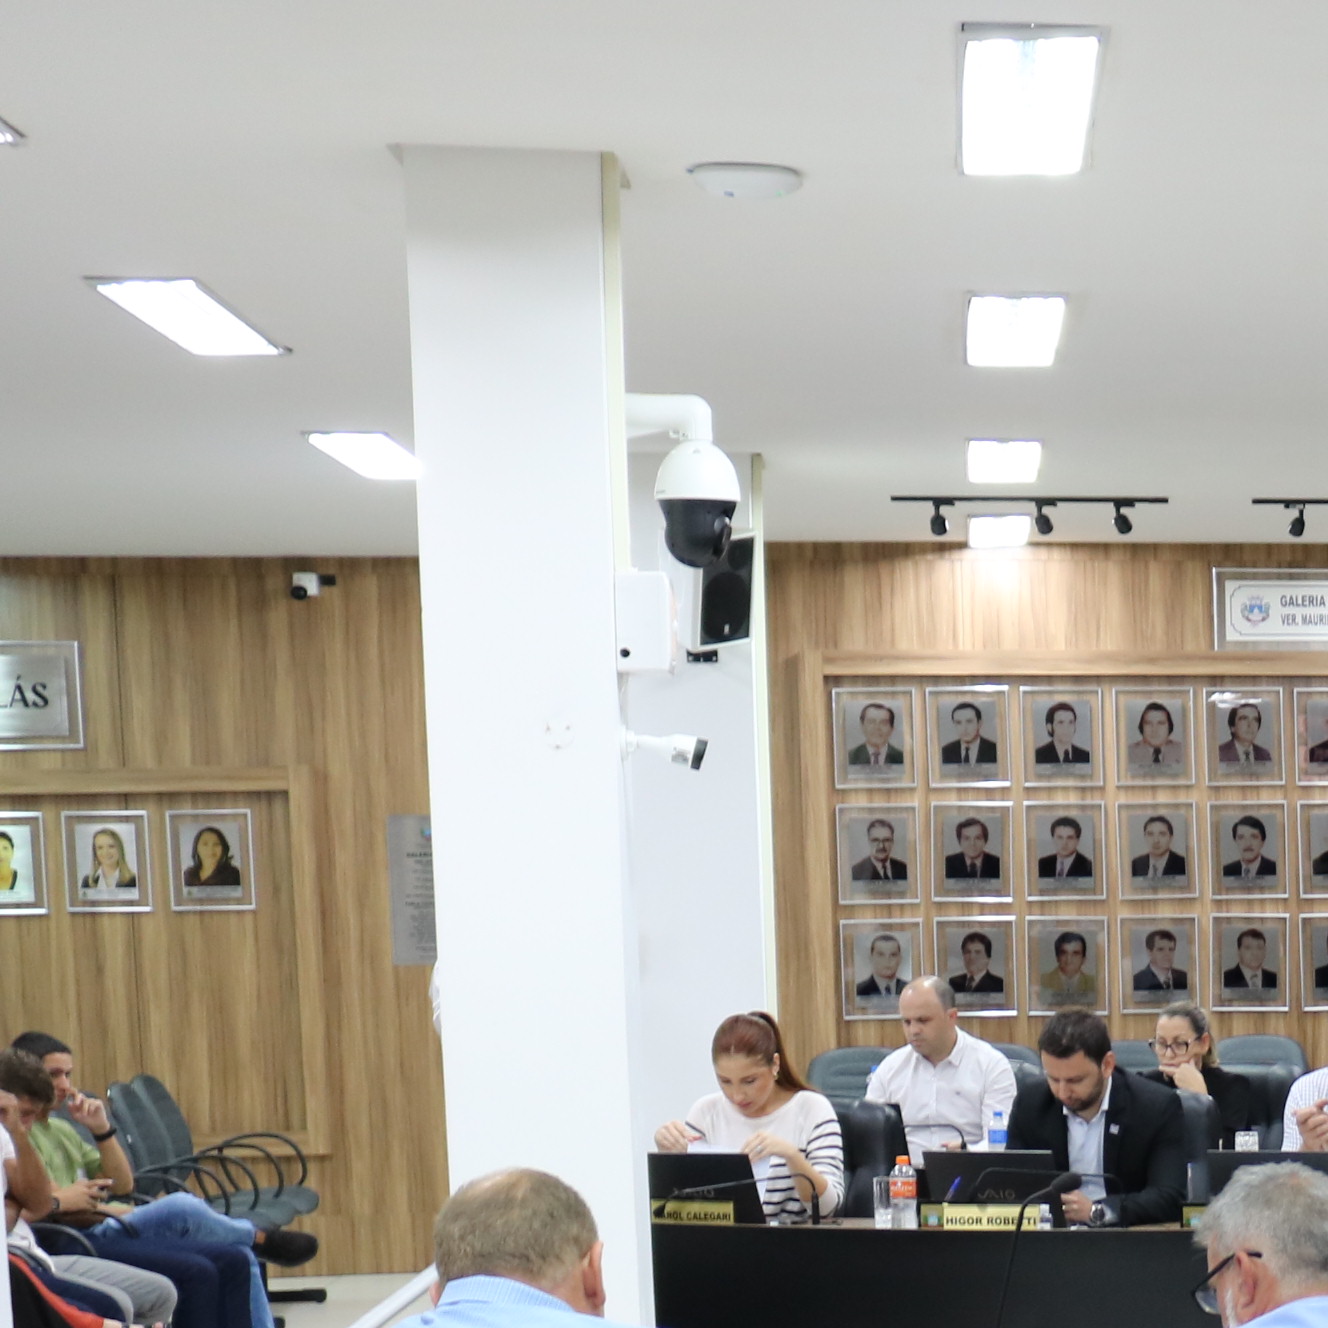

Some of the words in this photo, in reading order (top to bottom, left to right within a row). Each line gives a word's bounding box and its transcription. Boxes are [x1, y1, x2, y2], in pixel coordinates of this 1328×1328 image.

[1280, 594, 1326, 608] GALERIA
[1281, 613, 1299, 626] VER.
[0, 674, 49, 710] ÁS
[978, 1189, 1016, 1199] VAIO
[687, 1211, 731, 1221] CALEGARI
[946, 1216, 982, 1226] HIGOR
[987, 1216, 1037, 1226] ROBETI
